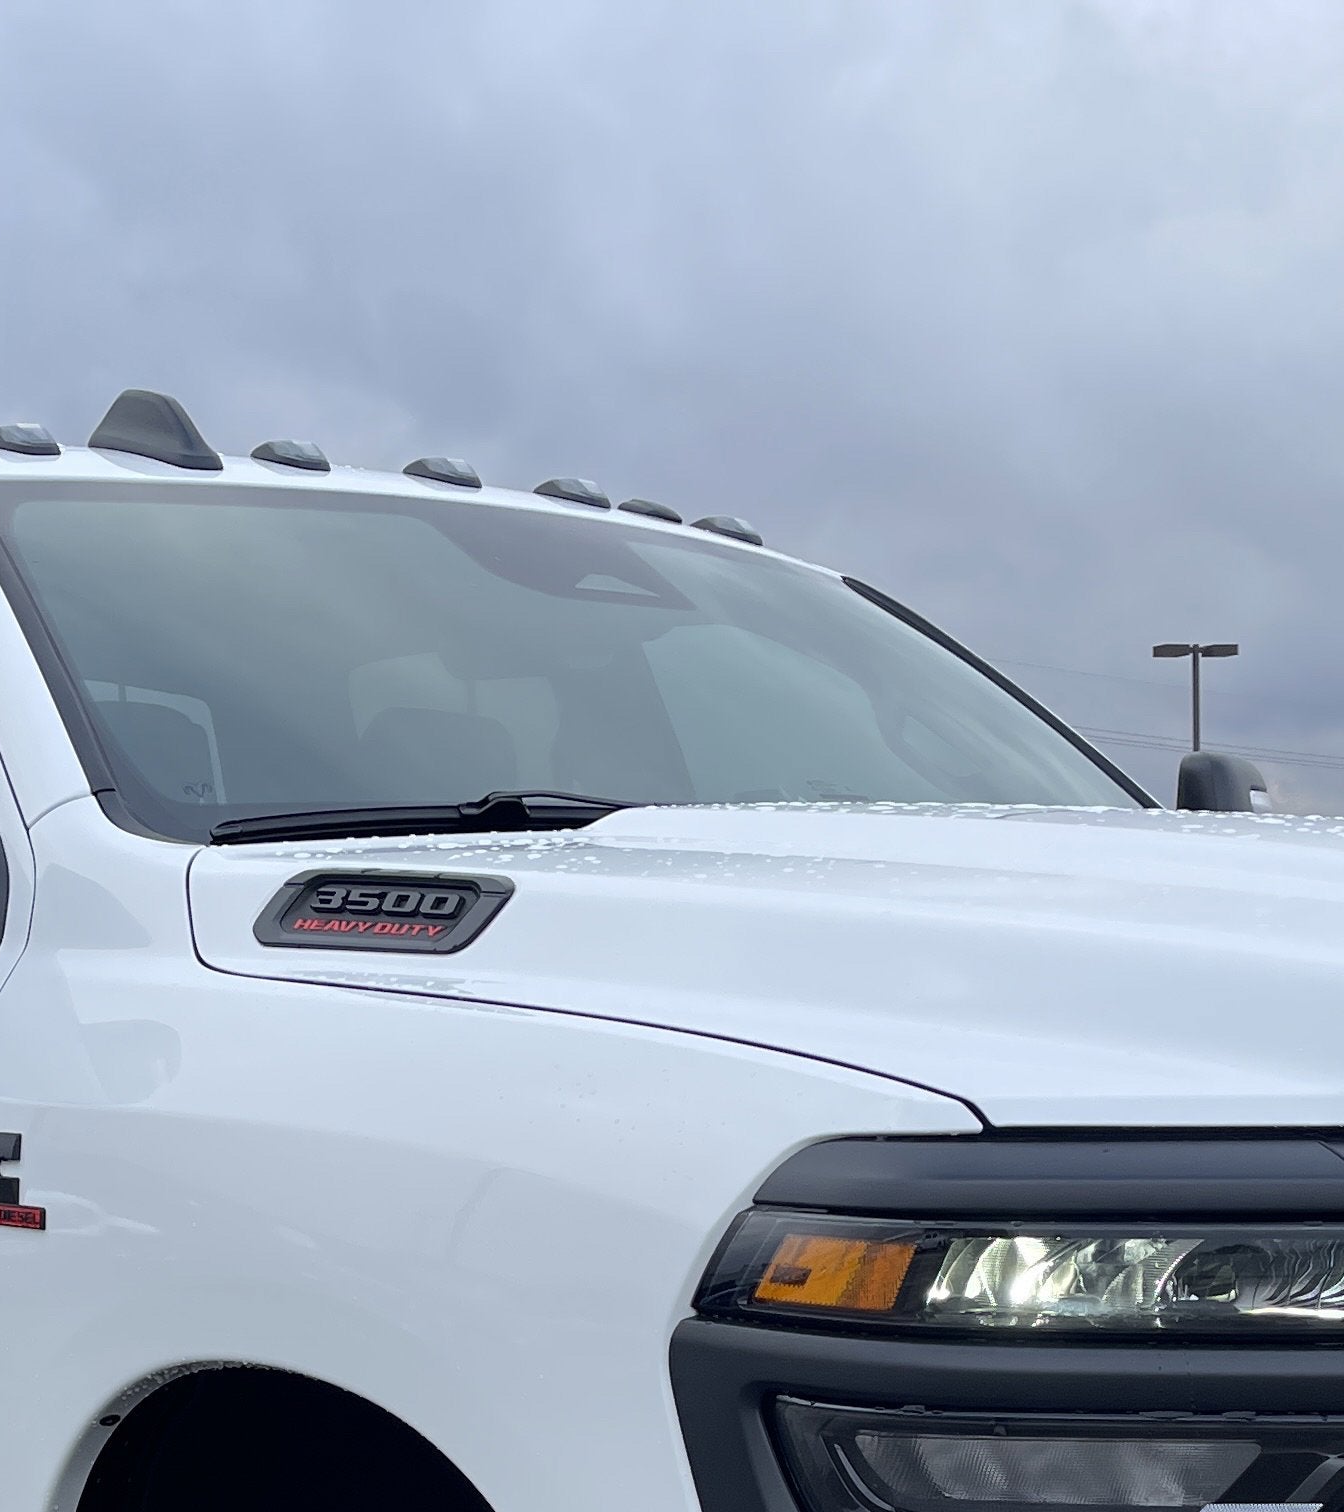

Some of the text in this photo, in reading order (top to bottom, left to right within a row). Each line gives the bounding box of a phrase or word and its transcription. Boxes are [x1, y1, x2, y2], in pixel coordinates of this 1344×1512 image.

[310, 887, 464, 919] 3500
[294, 918, 443, 938] HEAVY DUTY
[0, 1208, 40, 1226] DIESEL
